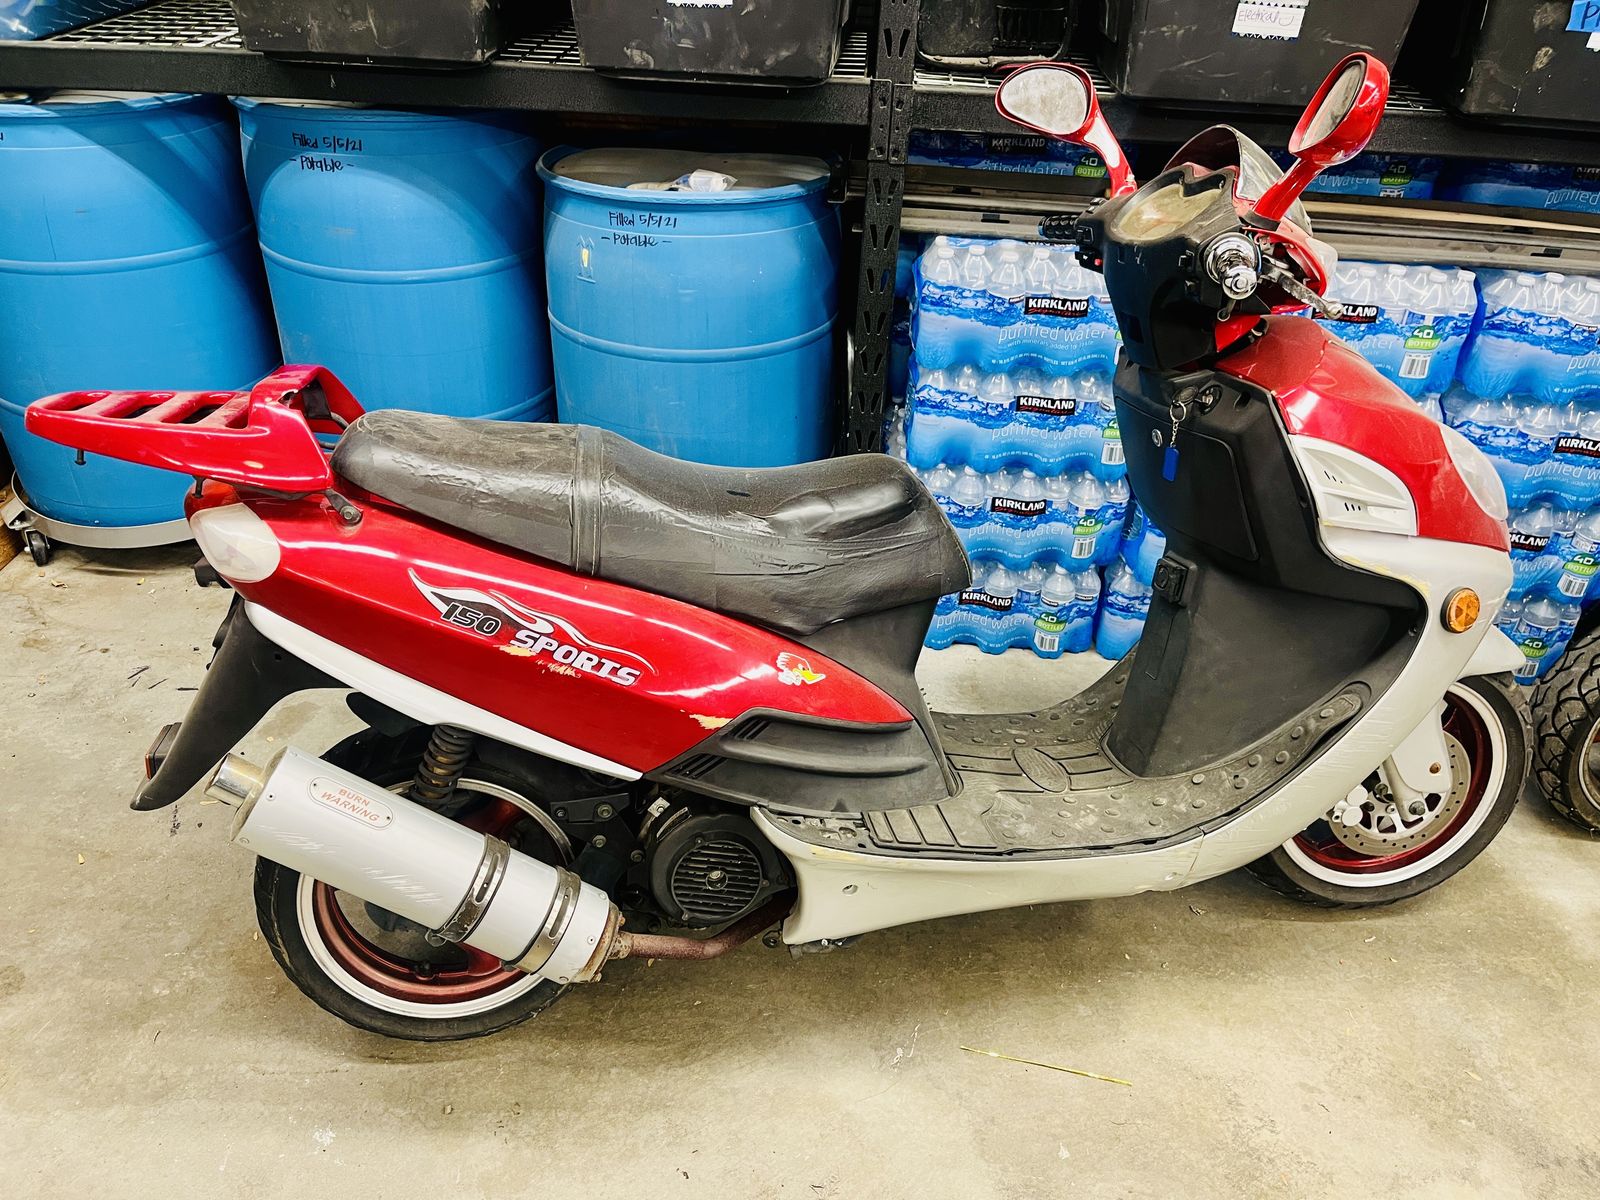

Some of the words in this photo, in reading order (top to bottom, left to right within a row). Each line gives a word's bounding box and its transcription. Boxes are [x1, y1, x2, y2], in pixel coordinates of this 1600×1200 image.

[292, 132, 319, 149] Filled
[992, 138, 1046, 148] KIRKLAND
[1081, 157, 1098, 166] 40
[1389, 165, 1407, 174] 40
[608, 211, 635, 227] Filled
[638, 212, 677, 228] 5/5/21
[1028, 298, 1088, 311] KIRKLAND
[998, 323, 1060, 344] purified
[1064, 328, 1107, 342] water
[1412, 329, 1434, 339] 40
[1019, 396, 1075, 409] KIRKLAND
[992, 423, 1048, 440] purified
[1053, 426, 1093, 439] water
[1524, 462, 1585, 480] purified
[995, 499, 1045, 511] KIRKLAND
[969, 520, 1022, 538] purified
[1026, 524, 1065, 538] water
[1573, 555, 1595, 565] 40
[962, 591, 1011, 607] KIRKLAND
[440, 601, 502, 637] 150
[936, 611, 988, 629] purified
[991, 617, 1026, 629] water
[1041, 613, 1057, 623] 40
[1525, 640, 1543, 648] 40
[509, 629, 643, 687] SPORTS
[338, 788, 370, 807] BURN
[321, 791, 380, 822] WARNING
